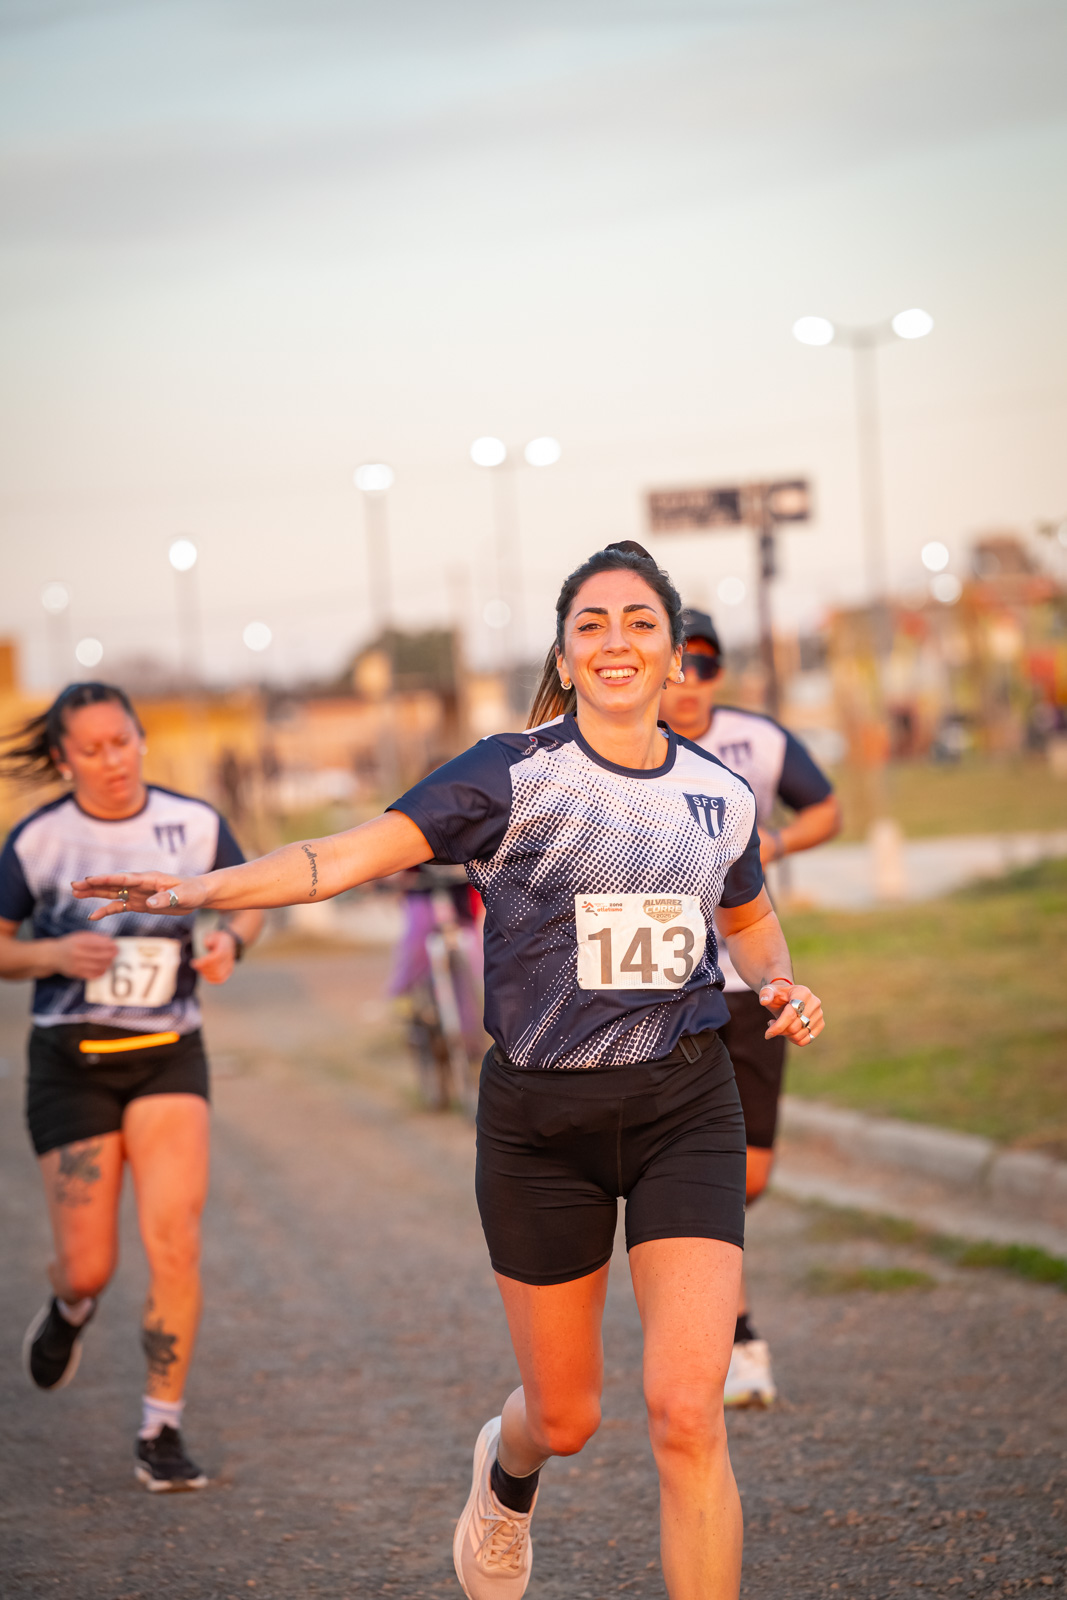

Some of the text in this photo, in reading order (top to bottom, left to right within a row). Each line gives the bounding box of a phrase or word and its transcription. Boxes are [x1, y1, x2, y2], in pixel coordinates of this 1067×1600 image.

[692, 796, 719, 809] SFC
[645, 905, 682, 913] CORRE
[588, 926, 695, 984] 143
[110, 961, 159, 999] 67
